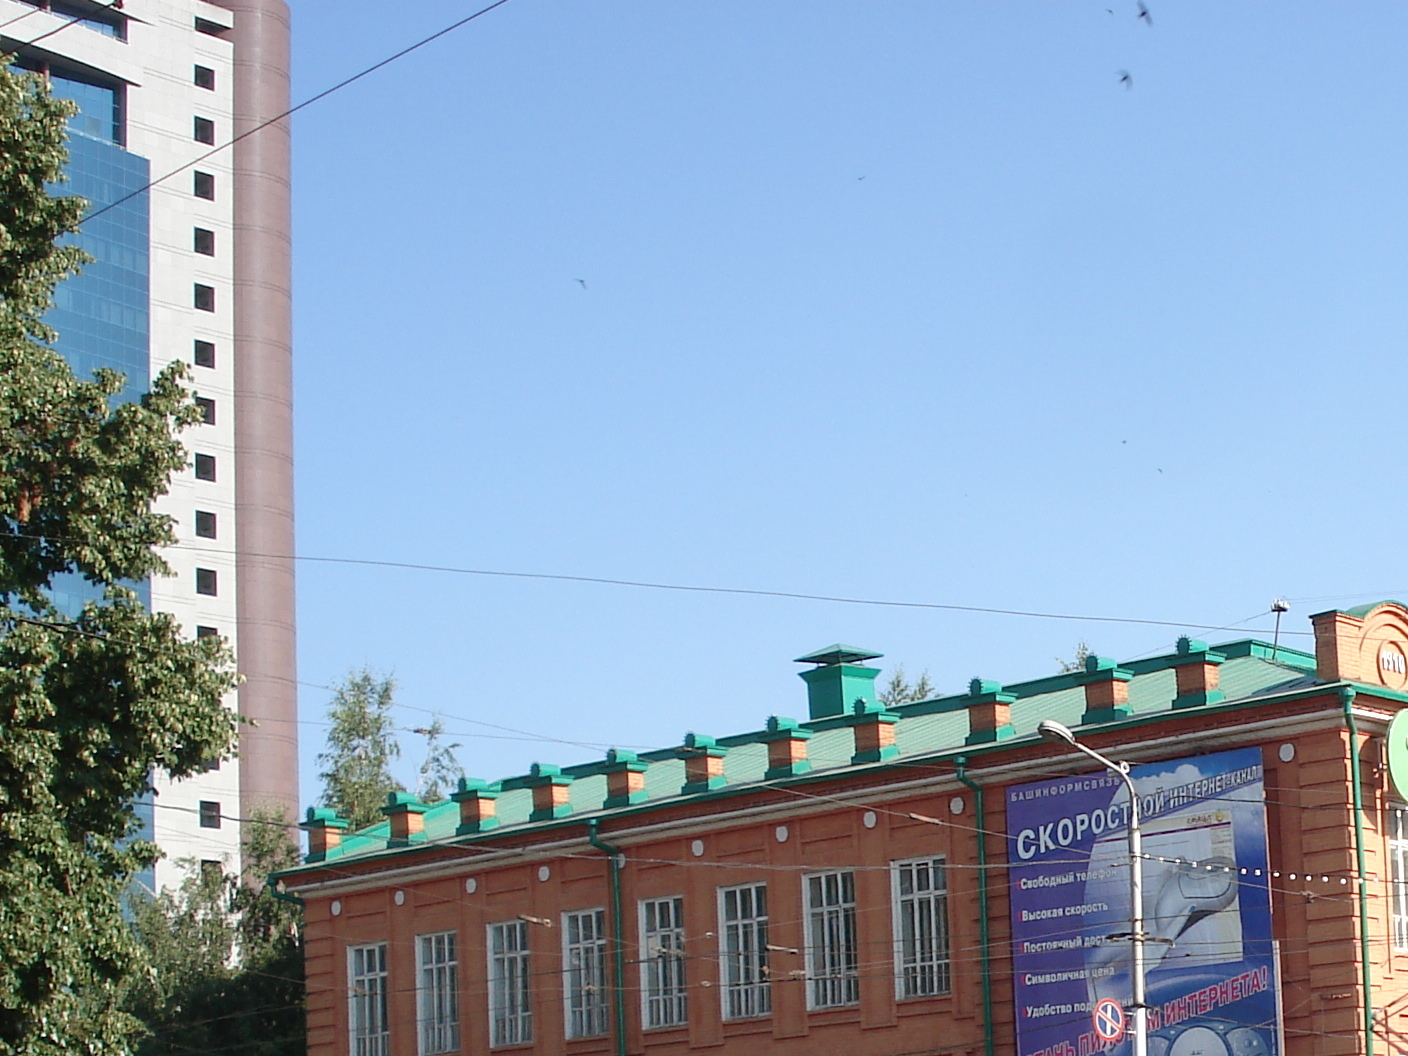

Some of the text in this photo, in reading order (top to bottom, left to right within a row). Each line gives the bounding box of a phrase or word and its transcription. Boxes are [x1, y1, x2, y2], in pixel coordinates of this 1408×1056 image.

[1011, 776, 1121, 802] БАШИНФОРМСВЯЗЬ
[1020, 867, 1117, 890] Свободный телефон
[1022, 902, 1108, 922] Высокая скорость
[1024, 936, 1082, 953] Постоянный
[1025, 966, 1115, 986] Символичная цена
[1164, 966, 1268, 1027] ИНТЕРНЕТА!
[1027, 1001, 1072, 1018] Удобство
